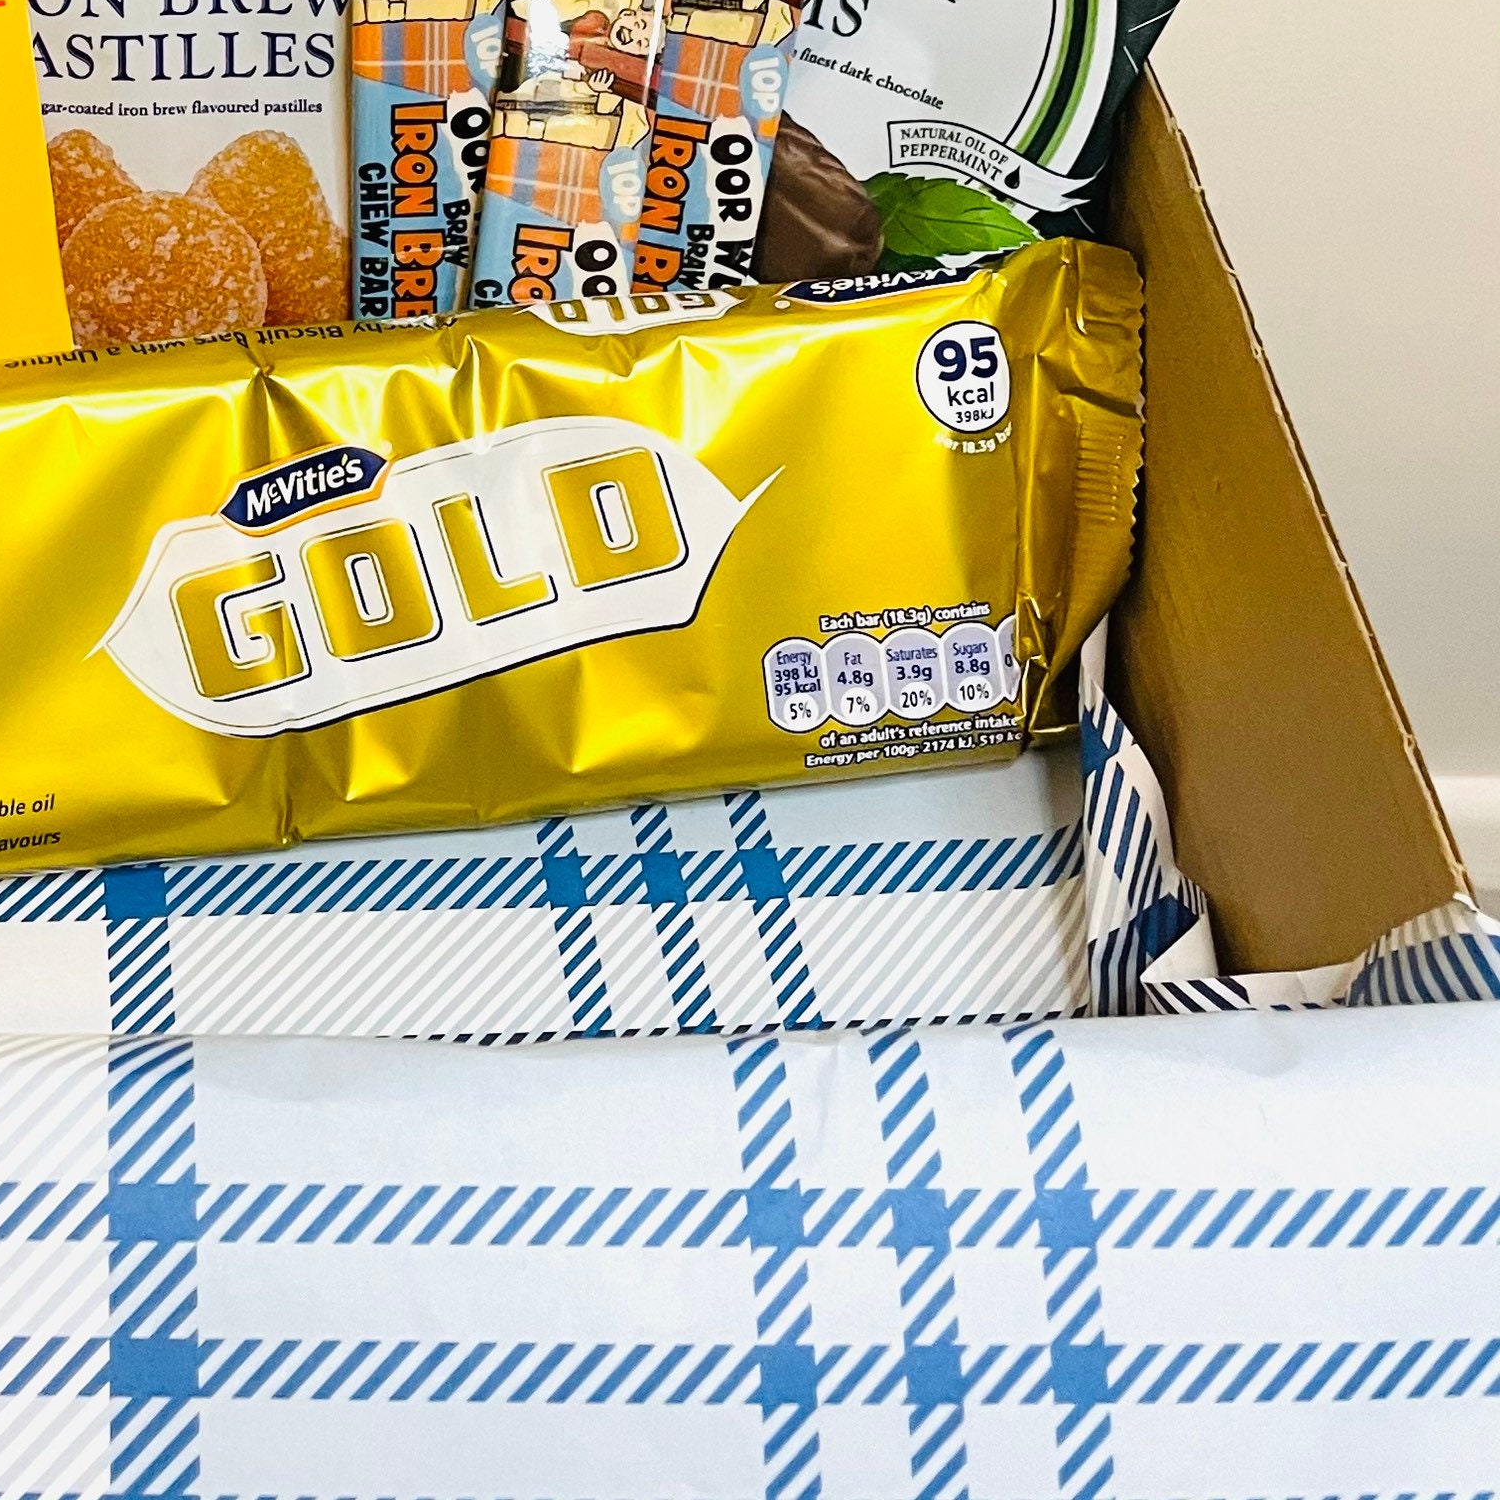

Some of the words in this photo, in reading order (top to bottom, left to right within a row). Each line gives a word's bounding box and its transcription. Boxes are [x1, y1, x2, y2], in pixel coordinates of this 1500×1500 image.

[32, 31, 336, 82] ASTILLES
[748, 57, 780, 115] 10P
[799, 47, 837, 72] finest
[839, 59, 874, 84] dark
[876, 71, 945, 111] chocolate
[42, 101, 114, 116] gar-coated
[118, 102, 149, 117] iron
[153, 100, 187, 116] brew
[192, 99, 259, 115] flavoured
[264, 99, 323, 117] pastilles
[390, 100, 447, 218] IRON
[900, 127, 962, 147] NATURAL
[964, 135, 987, 155] OIL
[986, 145, 1009, 166] OF
[646, 114, 712, 237] IRON
[900, 143, 1003, 183] PEPPERMINT
[710, 133, 754, 223] OOR
[358, 162, 389, 248] CHEW
[443, 199, 471, 269] BRAW
[360, 257, 388, 317] BAR
[256, 325, 344, 345] Biscuit
[933, 336, 999, 383] 95
[947, 381, 995, 407] kcal
[955, 407, 994, 424] 398kJ
[245, 452, 364, 521] McVitie's
[170, 446, 688, 701] GOLD
[820, 613, 854, 632] Each
[856, 611, 881, 629] bar
[883, 606, 932, 627] (18.3g)
[935, 602, 991, 620] contains
[776, 650, 812, 667] Energy
[844, 652, 862, 666] Fat
[886, 647, 938, 663] Saturates
[952, 641, 988, 658] Sugars
[774, 669, 801, 684] 398
[804, 666, 819, 678] kJ
[837, 671, 875, 687] 4.8g
[896, 666, 933, 682] 3.9g
[954, 659, 991, 676] 8.8g
[774, 683, 793, 697] 95
[794, 679, 822, 694] kcal
[901, 689, 933, 709] 20%
[959, 683, 990, 701] 10%
[789, 701, 812, 721] 5%
[846, 695, 871, 714] 7%
[820, 733, 838, 749] of
[839, 733, 858, 746] an
[859, 726, 906, 744] adult's
[907, 720, 973, 738] reference
[974, 715, 1018, 730] intake
[806, 751, 853, 768] Energy
[856, 749, 881, 765] per
[883, 742, 920, 760] 100g:
[922, 739, 956, 754] 2174
[980, 732, 1005, 748] 519
[32, 794, 55, 813] oil
